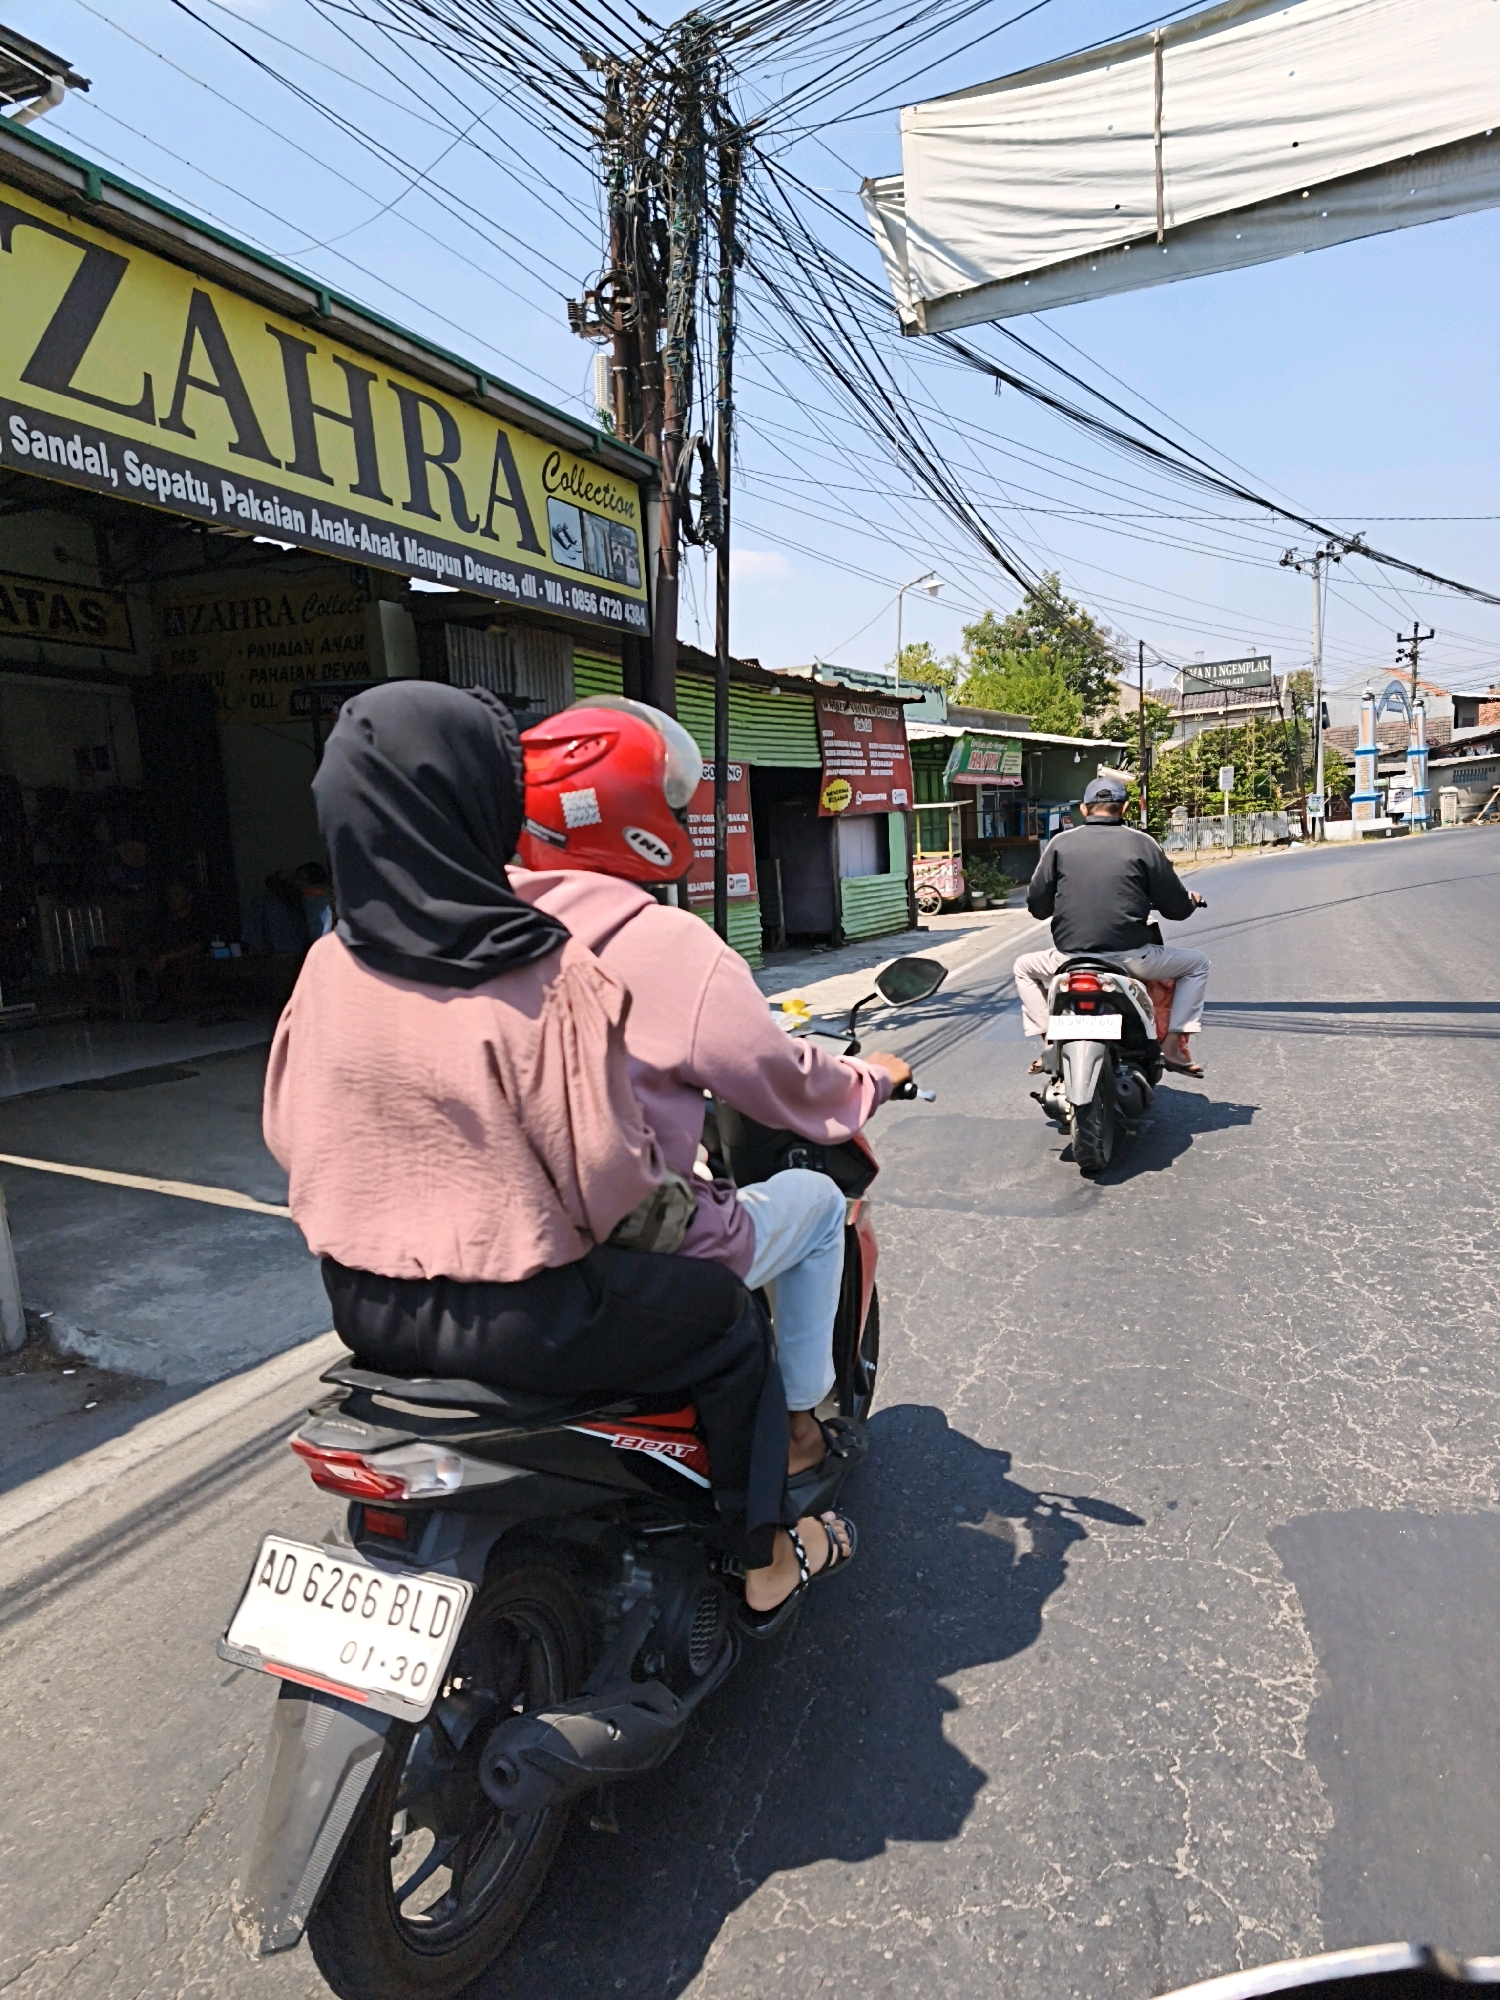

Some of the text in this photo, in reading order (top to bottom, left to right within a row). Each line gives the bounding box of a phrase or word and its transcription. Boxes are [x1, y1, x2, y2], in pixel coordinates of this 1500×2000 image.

[542, 450, 635, 518] Collection
[9, 415, 119, 487] Sandal,
[123, 450, 218, 515] Sepatu,
[220, 480, 306, 534] Pakaian
[311, 508, 402, 561] Anak-Anak
[403, 536, 462, 579] Maupun
[464, 554, 520, 598] Dewasa,
[520, 572, 537, 598] dll
[571, 589, 597, 615] 0856
[599, 596, 622, 621] 4720
[624, 605, 646, 627] 4384
[1218, 659, 1270, 677] NGEMPLAK
[630, 832, 669, 860] INK
[258, 1549, 452, 1639] AD 6266 BLD
